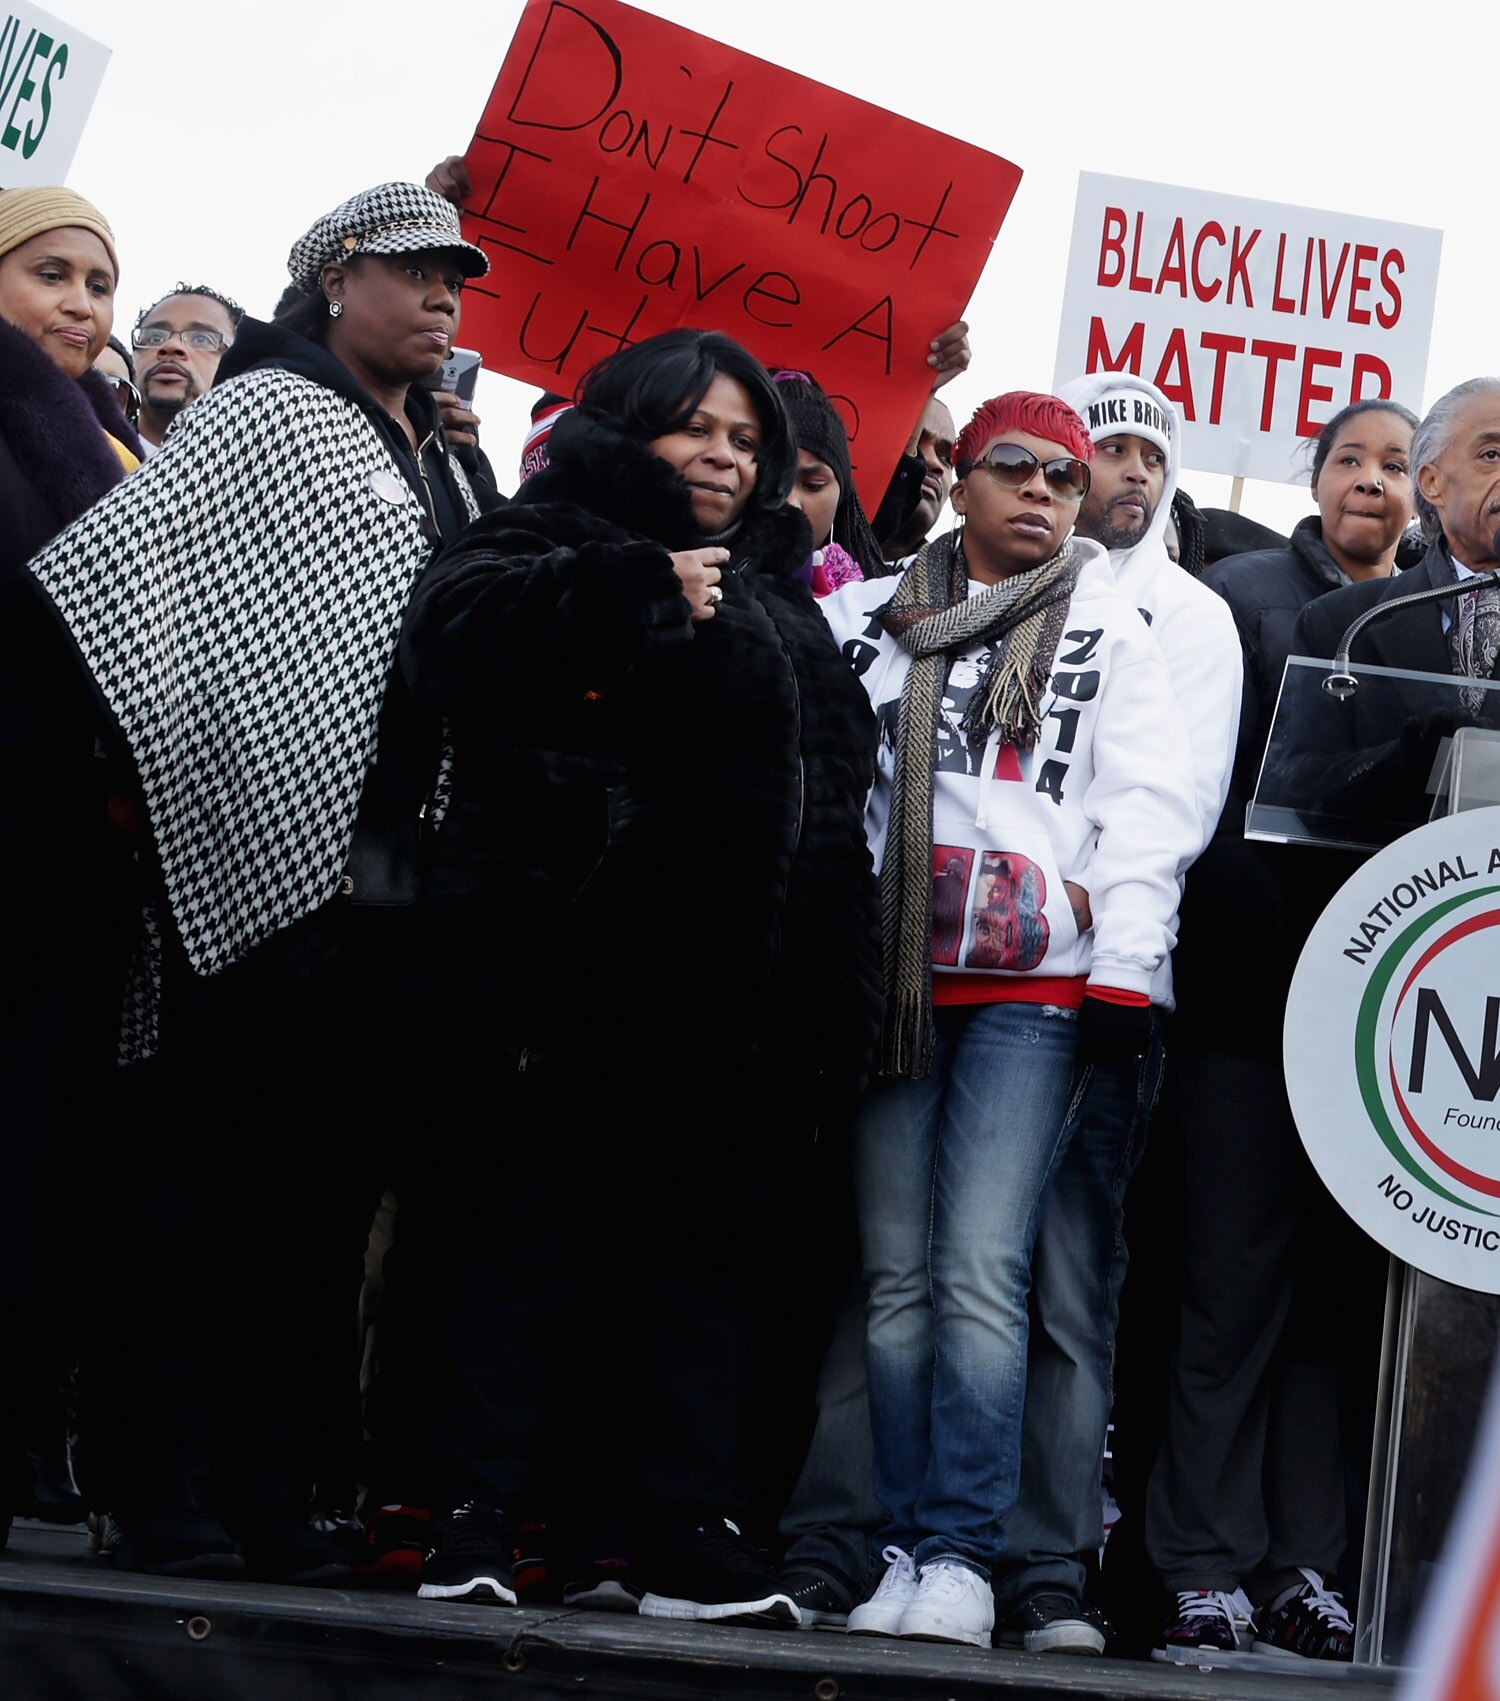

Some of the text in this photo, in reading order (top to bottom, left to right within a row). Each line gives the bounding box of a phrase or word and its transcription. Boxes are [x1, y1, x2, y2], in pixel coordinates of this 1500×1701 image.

[0, 14, 69, 160] VES
[464, 134, 893, 376] I Have A
[737, 125, 959, 271] Shoot
[1097, 206, 1406, 330] BLACK LIVES
[1088, 399, 1127, 430] MIKE
[1342, 855, 1479, 966] NATIONAL
[1376, 1174, 1414, 1212] NO
